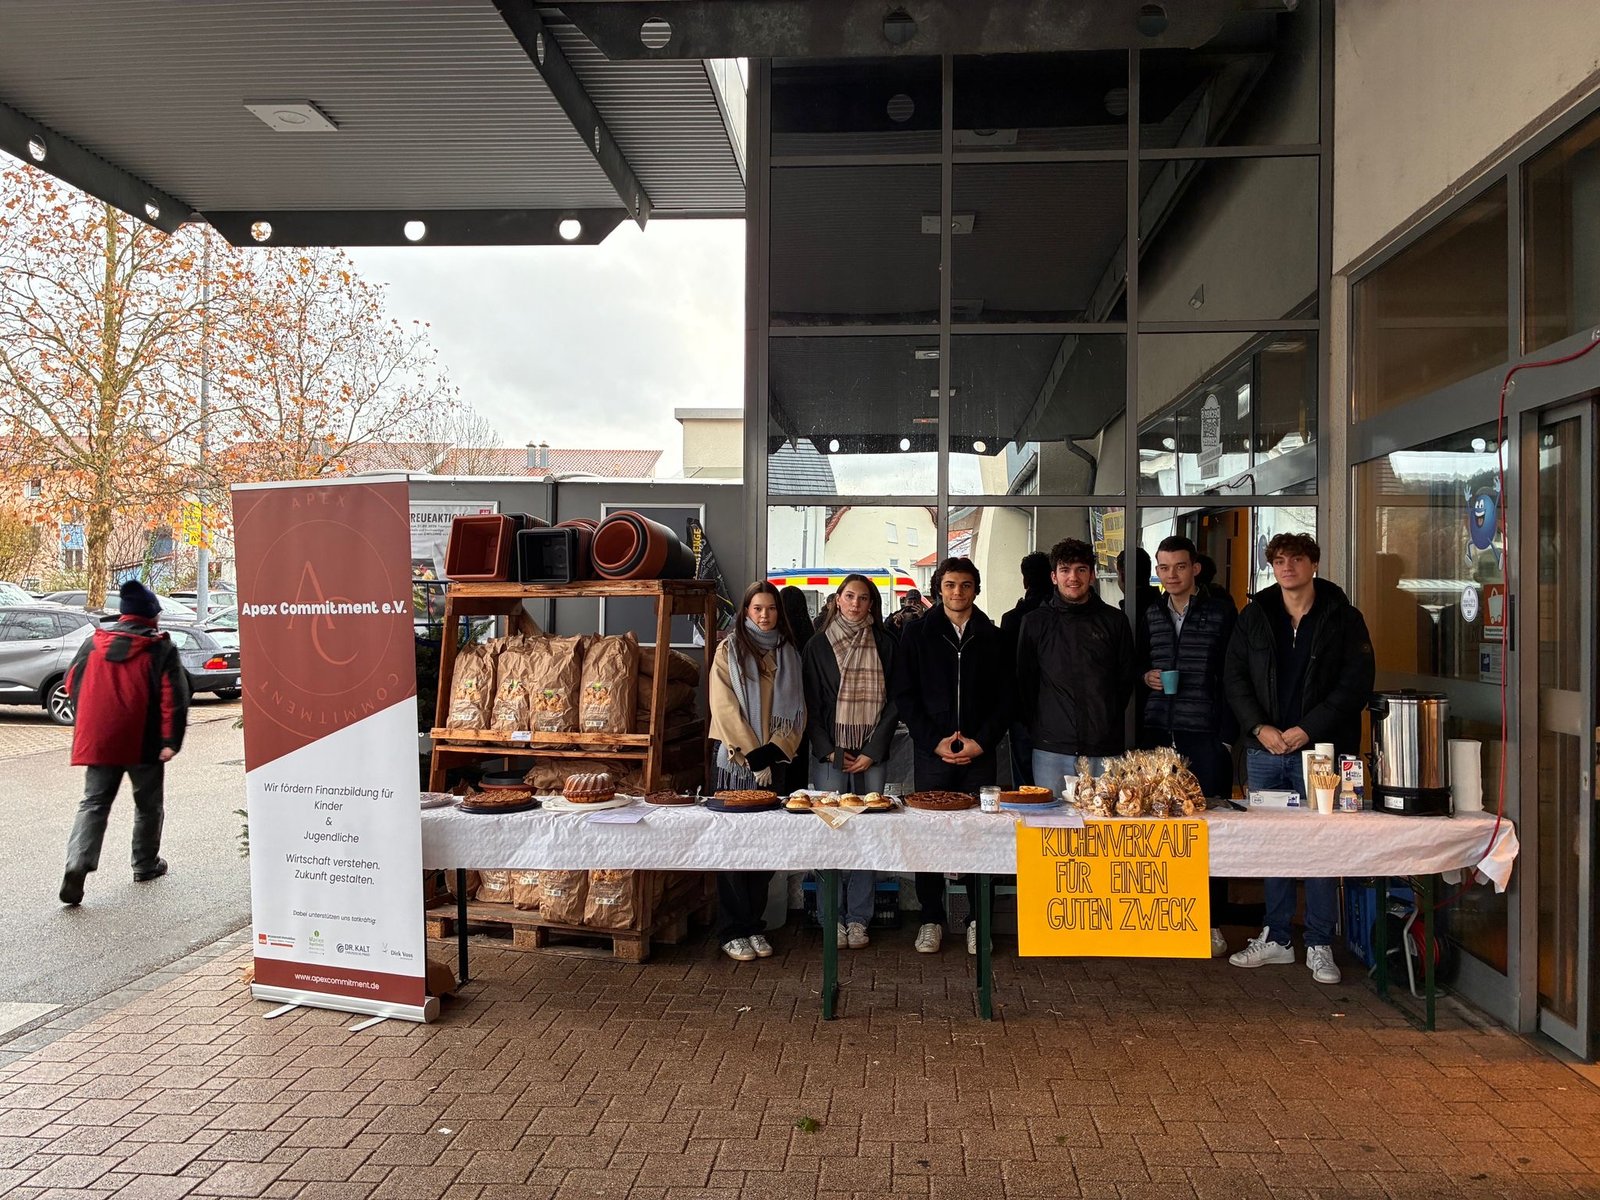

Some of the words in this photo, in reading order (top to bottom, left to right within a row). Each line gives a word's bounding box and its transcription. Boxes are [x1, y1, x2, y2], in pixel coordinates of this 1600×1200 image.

[292, 492, 346, 509] APEX
[242, 602, 277, 617] Apex
[280, 600, 379, 615] Commitment
[383, 600, 407, 614] e.V.
[264, 783, 278, 793] Wir
[280, 783, 313, 795] fördern
[315, 785, 379, 800] Finanzbildung
[381, 788, 394, 799] für
[314, 801, 343, 811] Kinder
[325, 817, 333, 826] &
[303, 831, 360, 843] Jugendliche
[1041, 824, 1199, 858] KUCHENVERKAUF
[285, 853, 331, 866] Wirtschaft
[333, 858, 380, 870] verstehen.
[294, 869, 327, 881] Zukunft
[329, 872, 375, 885] gestalten.
[1055, 859, 1093, 894] FÜR
[1110, 861, 1169, 894] EINEN
[1047, 897, 1113, 931] GUTEN
[1119, 897, 1198, 932] ZWECK
[354, 945, 370, 953] KALT
[294, 973, 380, 990] www.apexcommitment.de
